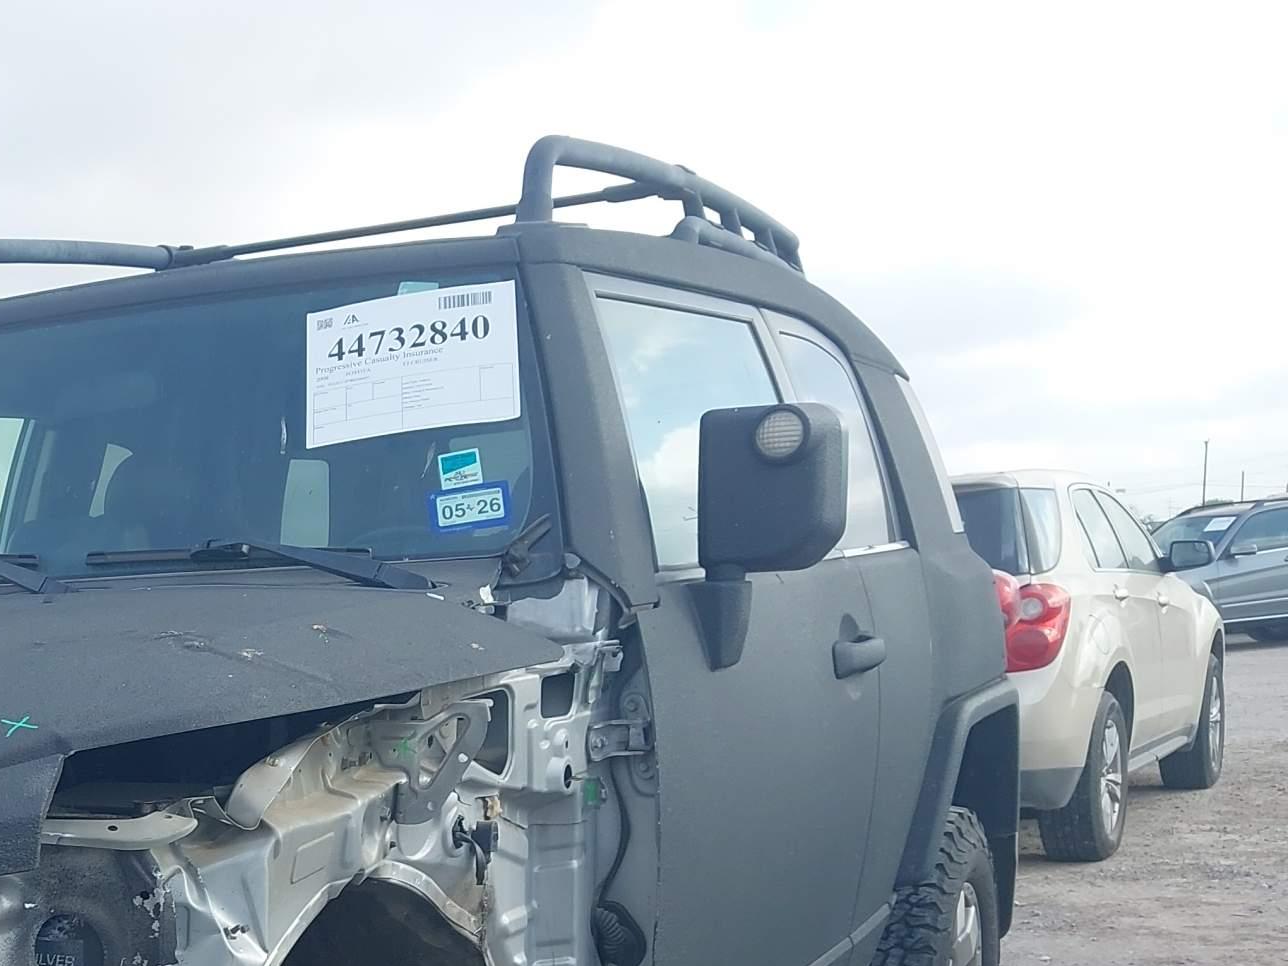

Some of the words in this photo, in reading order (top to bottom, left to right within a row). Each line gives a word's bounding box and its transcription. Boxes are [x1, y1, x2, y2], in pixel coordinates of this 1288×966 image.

[328, 315, 490, 361] 44732840
[315, 361, 362, 375] Progressive
[364, 353, 400, 366] Casualty
[402, 347, 444, 360] Insurance
[442, 502, 466, 520] 05
[477, 497, 501, 515] 26
